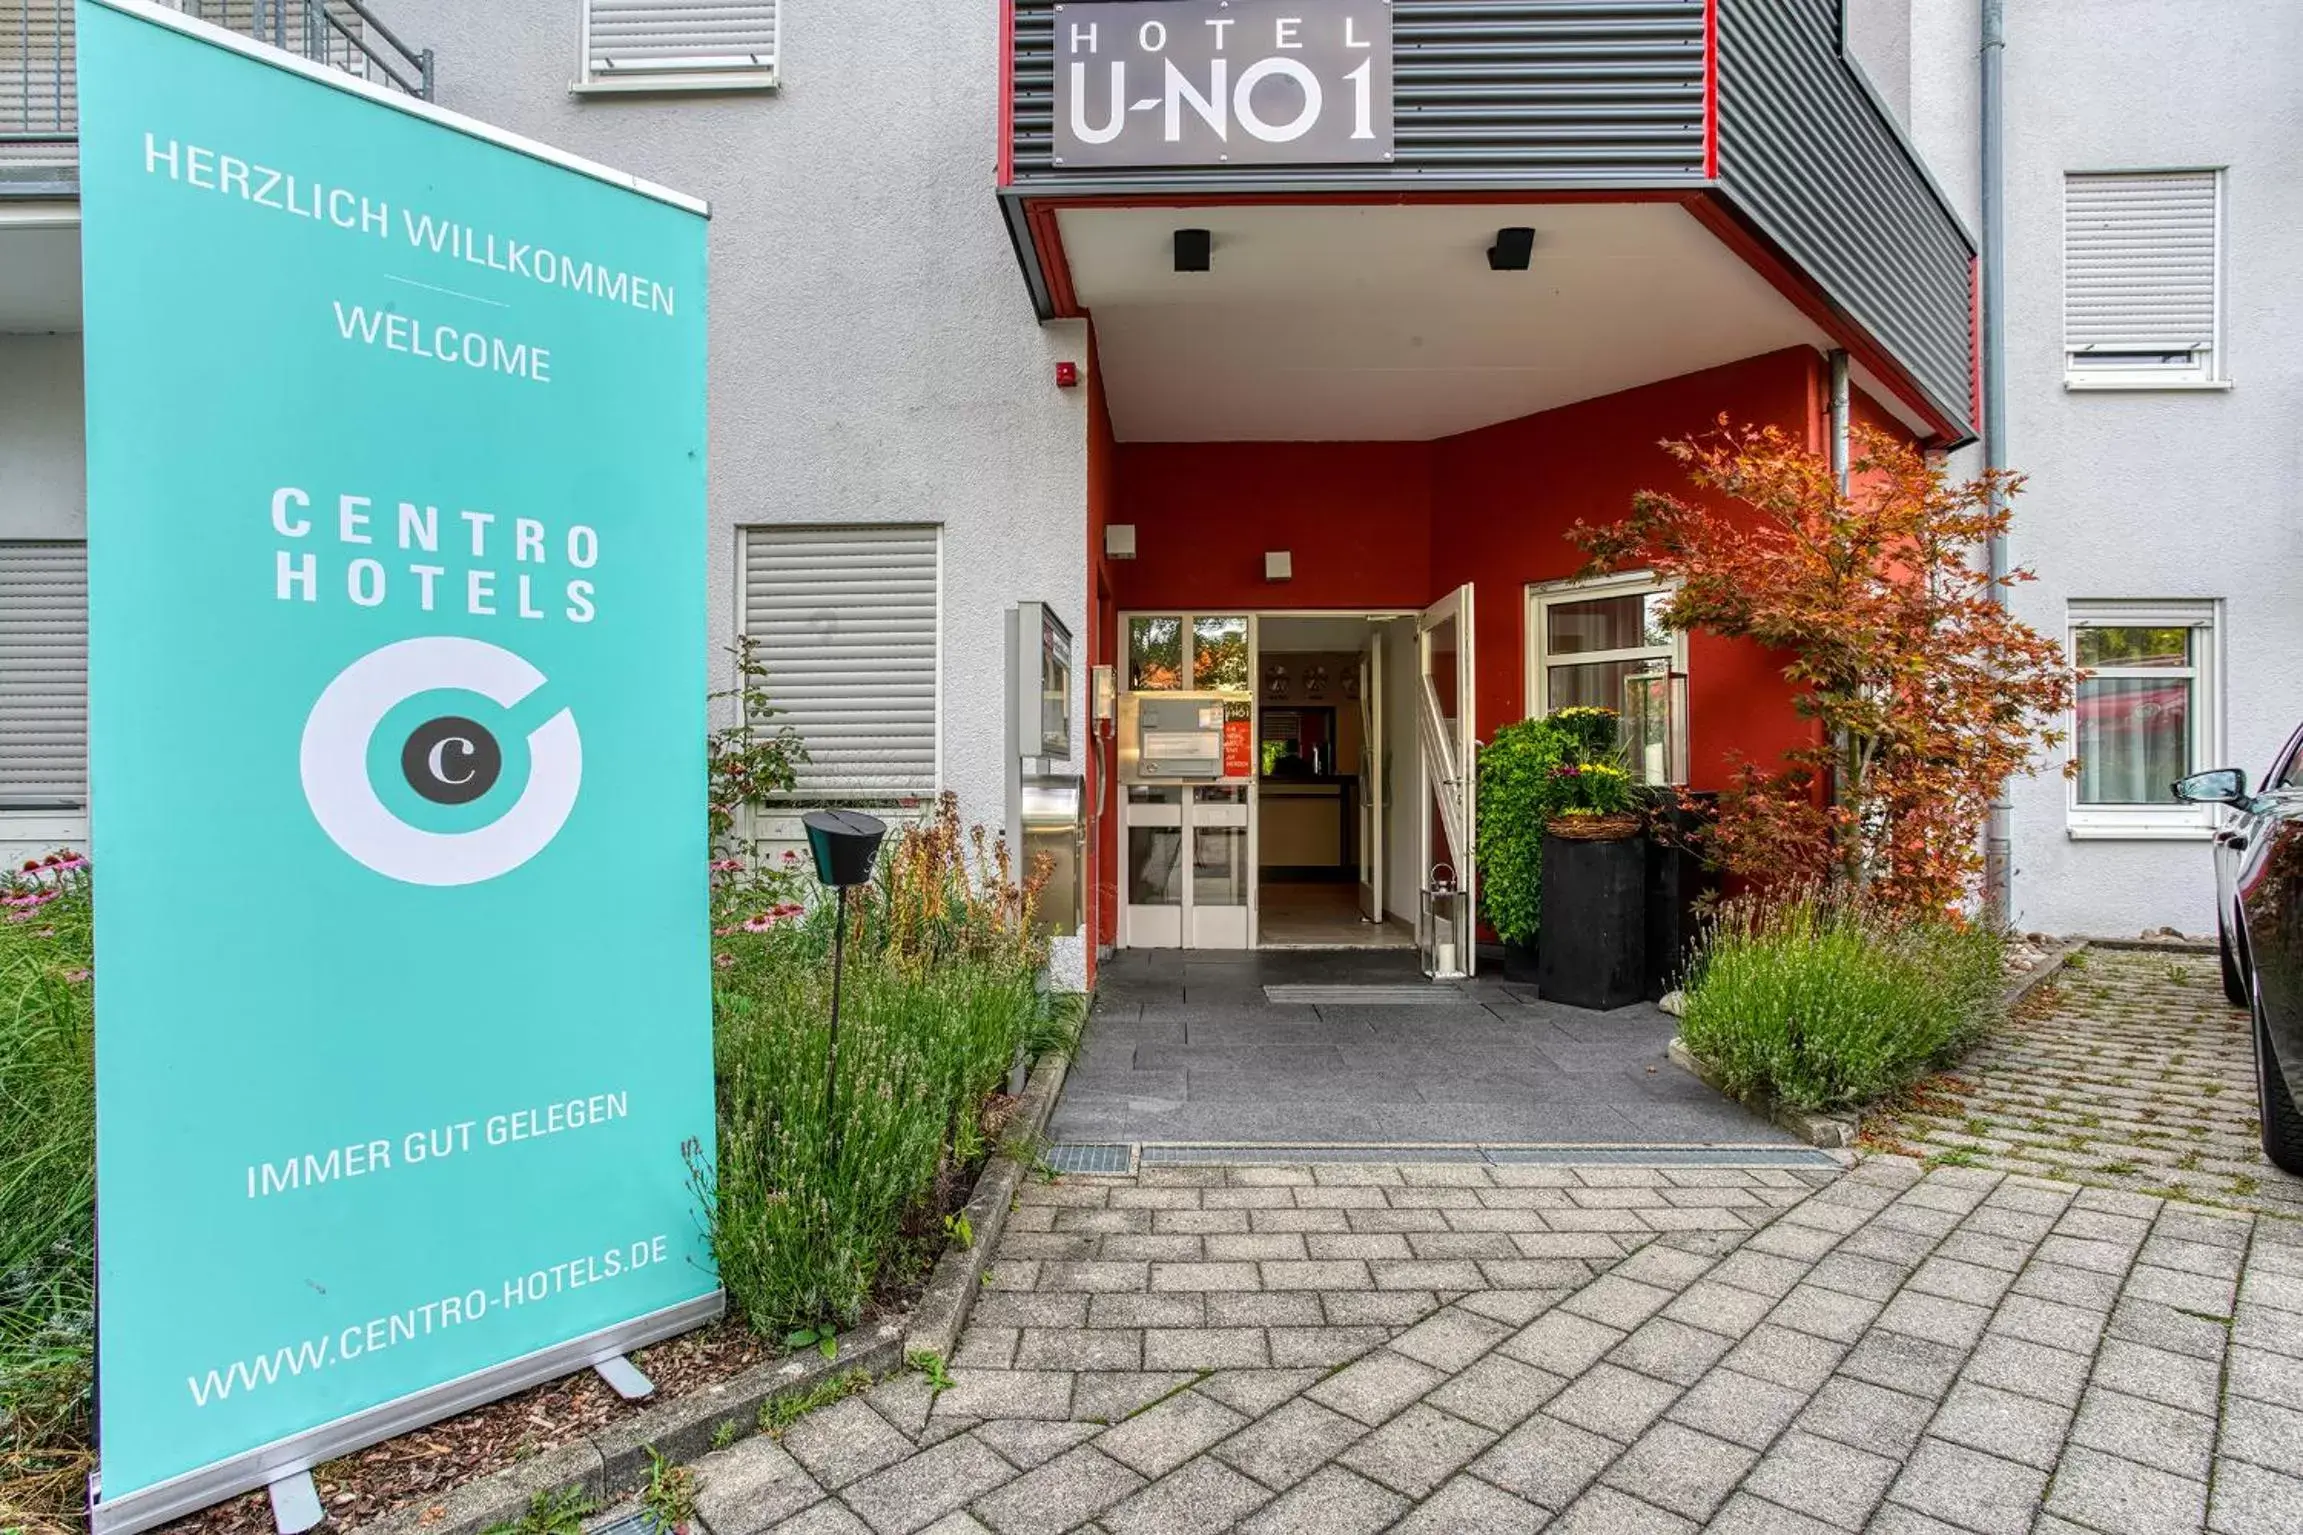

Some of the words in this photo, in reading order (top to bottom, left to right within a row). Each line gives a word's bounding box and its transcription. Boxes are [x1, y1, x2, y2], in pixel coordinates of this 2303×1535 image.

[1070, 16, 1372, 53] HOTEL
[143, 131, 389, 238] HERZLICH
[402, 208, 675, 317] WILLKOMMEN
[332, 300, 552, 383] WELCOME
[270, 486, 600, 570] CENTRO
[275, 550, 597, 624] HOTELS
[246, 1138, 392, 1199] IMMER
[403, 1121, 475, 1163] GUT
[485, 1090, 629, 1146] GELEGEN
[187, 1235, 669, 1408] WWW.CENTRO-HOTELS.DE
